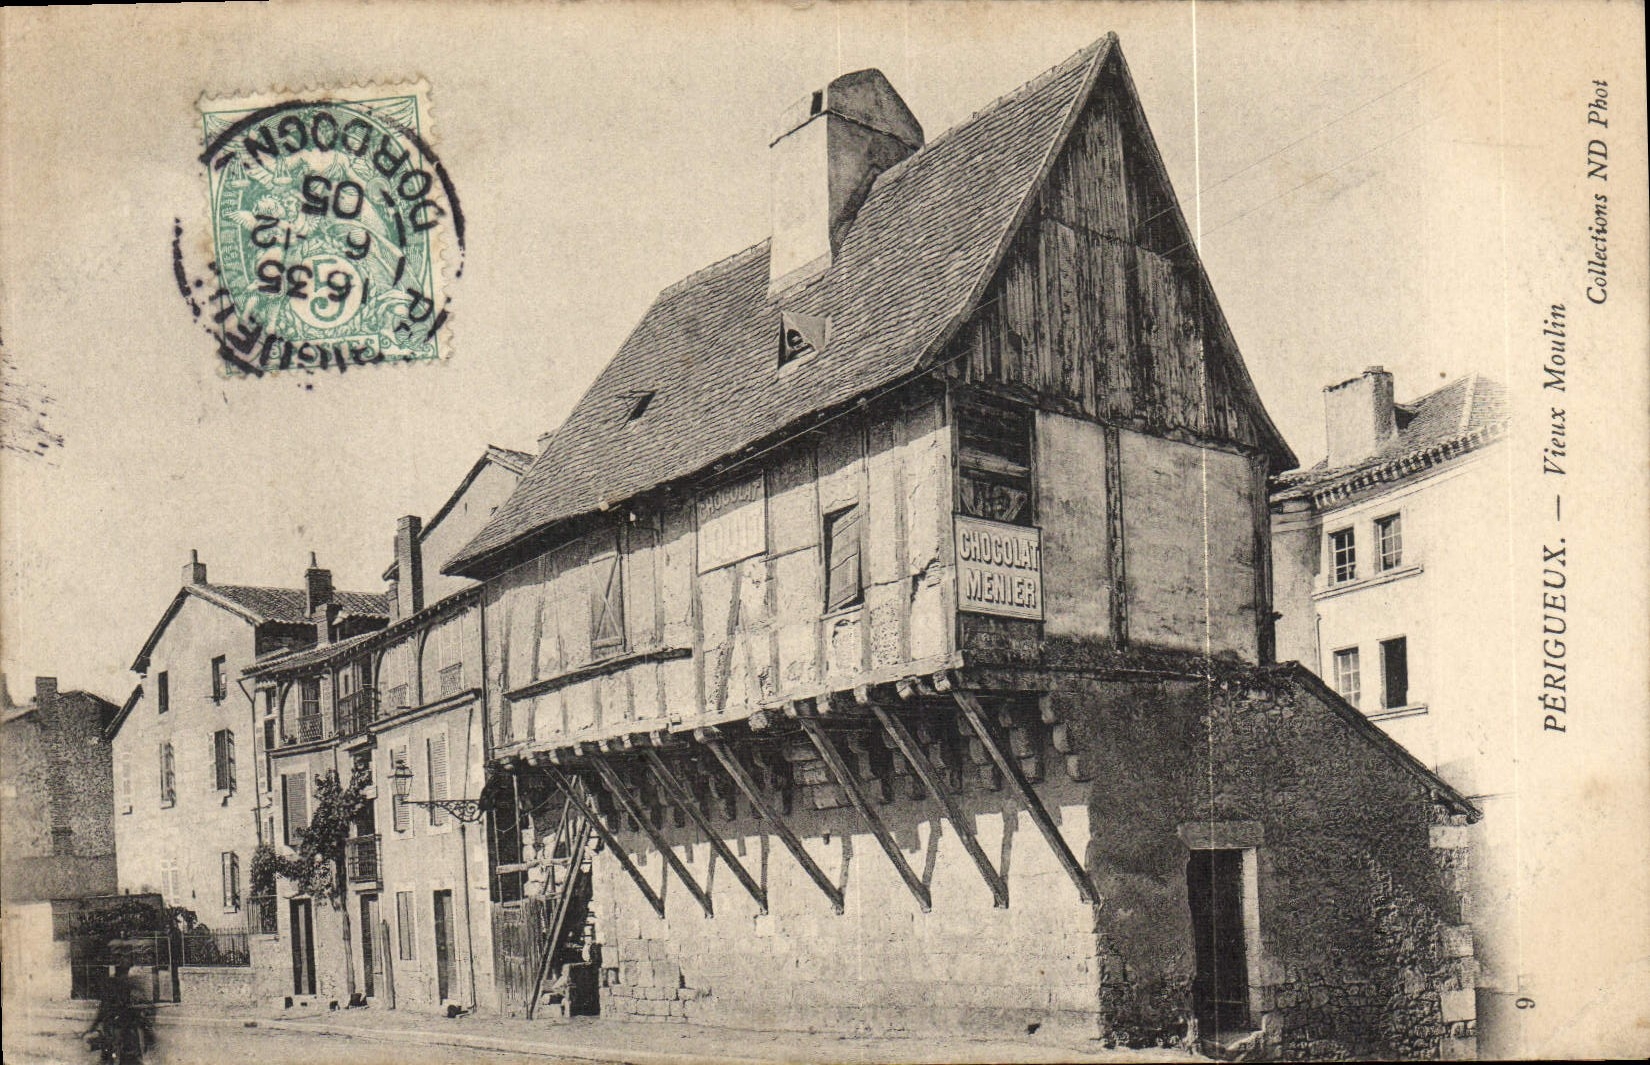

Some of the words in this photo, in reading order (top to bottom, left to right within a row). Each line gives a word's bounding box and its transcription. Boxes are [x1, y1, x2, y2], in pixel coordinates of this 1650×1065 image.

[302, 175, 363, 219] 05
[700, 481, 761, 522] CHOCOLAT
[959, 527, 1040, 571] CHOCOLAT
[966, 567, 1037, 609] MENIER
